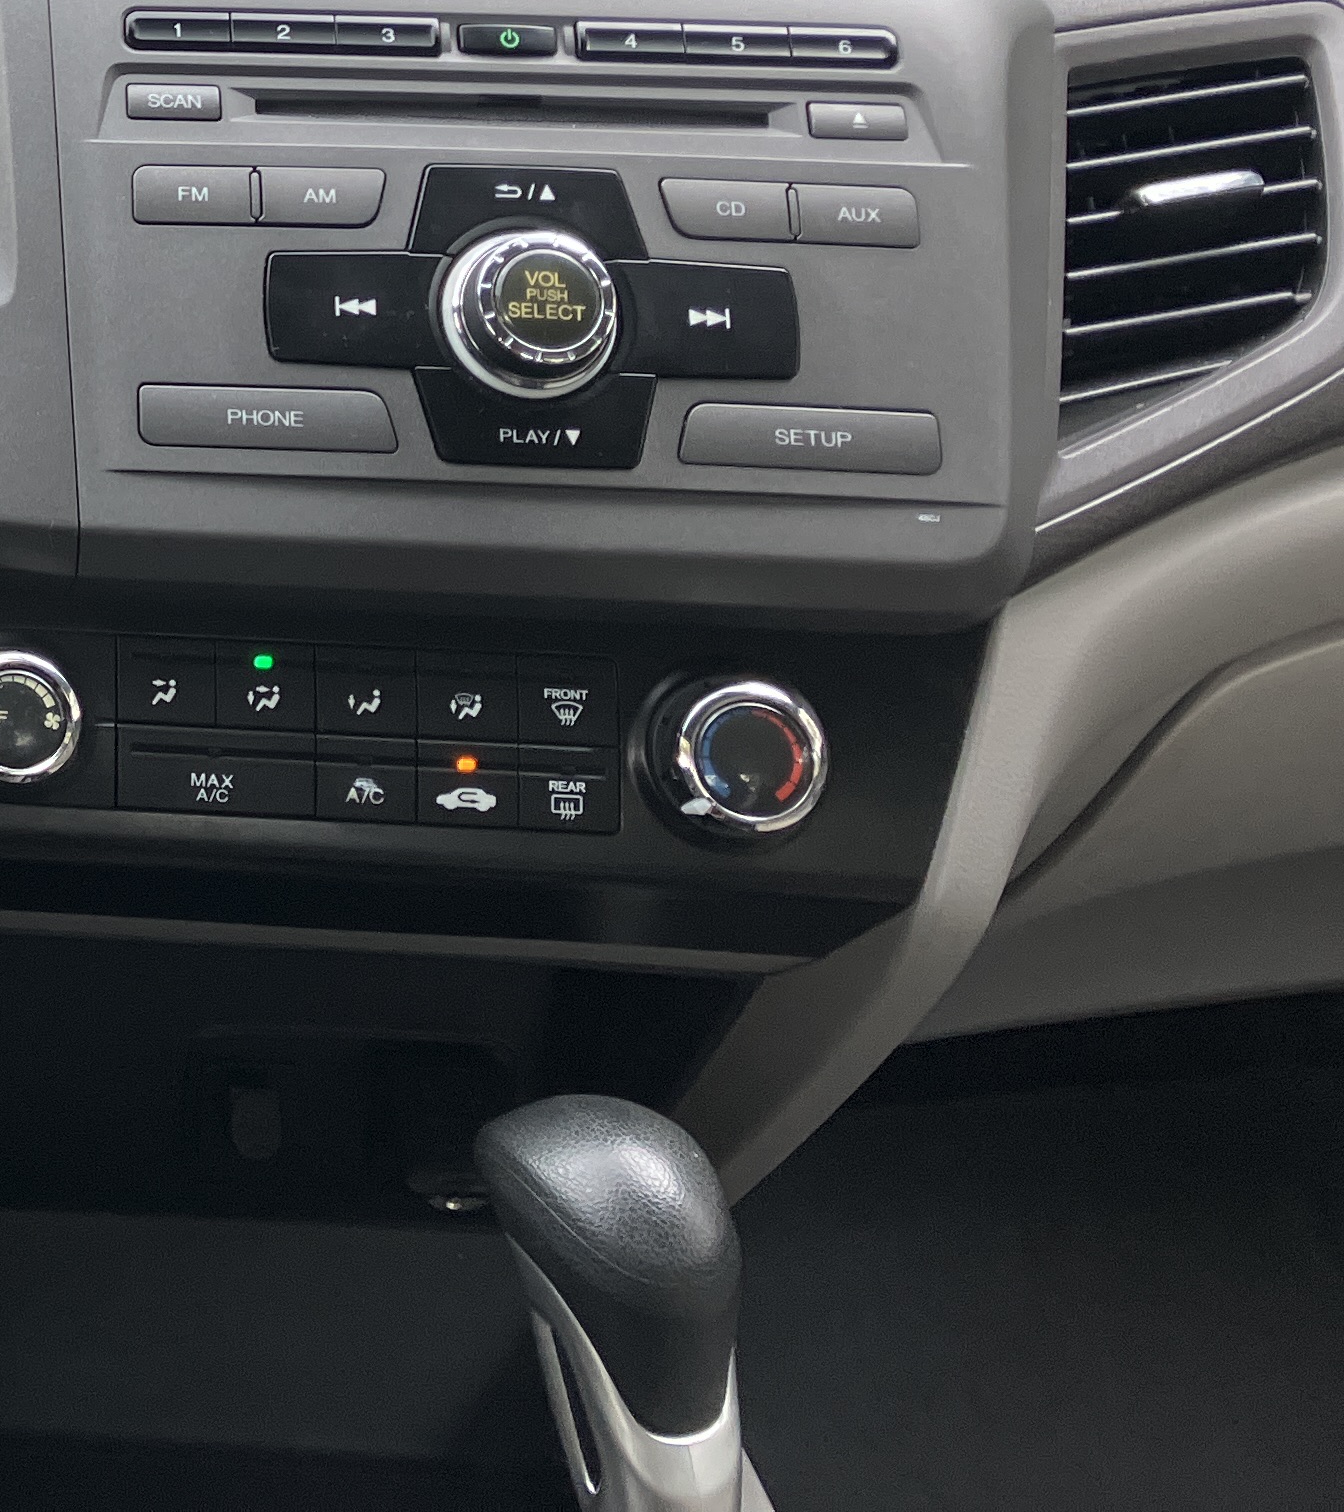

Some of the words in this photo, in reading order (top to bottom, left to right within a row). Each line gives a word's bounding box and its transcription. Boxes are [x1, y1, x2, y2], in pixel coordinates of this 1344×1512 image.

[172, 23, 182, 39] 1
[276, 24, 292, 40] 2
[380, 27, 396, 44] 3
[624, 33, 638, 49] 4
[731, 36, 745, 52] 5
[838, 39, 852, 55] 6
[147, 92, 203, 110] SCAN
[177, 186, 209, 203] FM
[303, 188, 337, 204] AM
[715, 200, 746, 217] CD
[837, 206, 882, 223] AUX
[524, 270, 566, 288] VOL
[526, 288, 569, 302] PUSH
[508, 303, 586, 322] SELECT
[226, 408, 305, 428] PHONE
[774, 427, 853, 448] SETUP
[543, 687, 589, 702] FRONT
[190, 772, 235, 790] MAX
[548, 779, 587, 794] REAR
[196, 788, 230, 804] A/C
[345, 786, 385, 805] A/C
